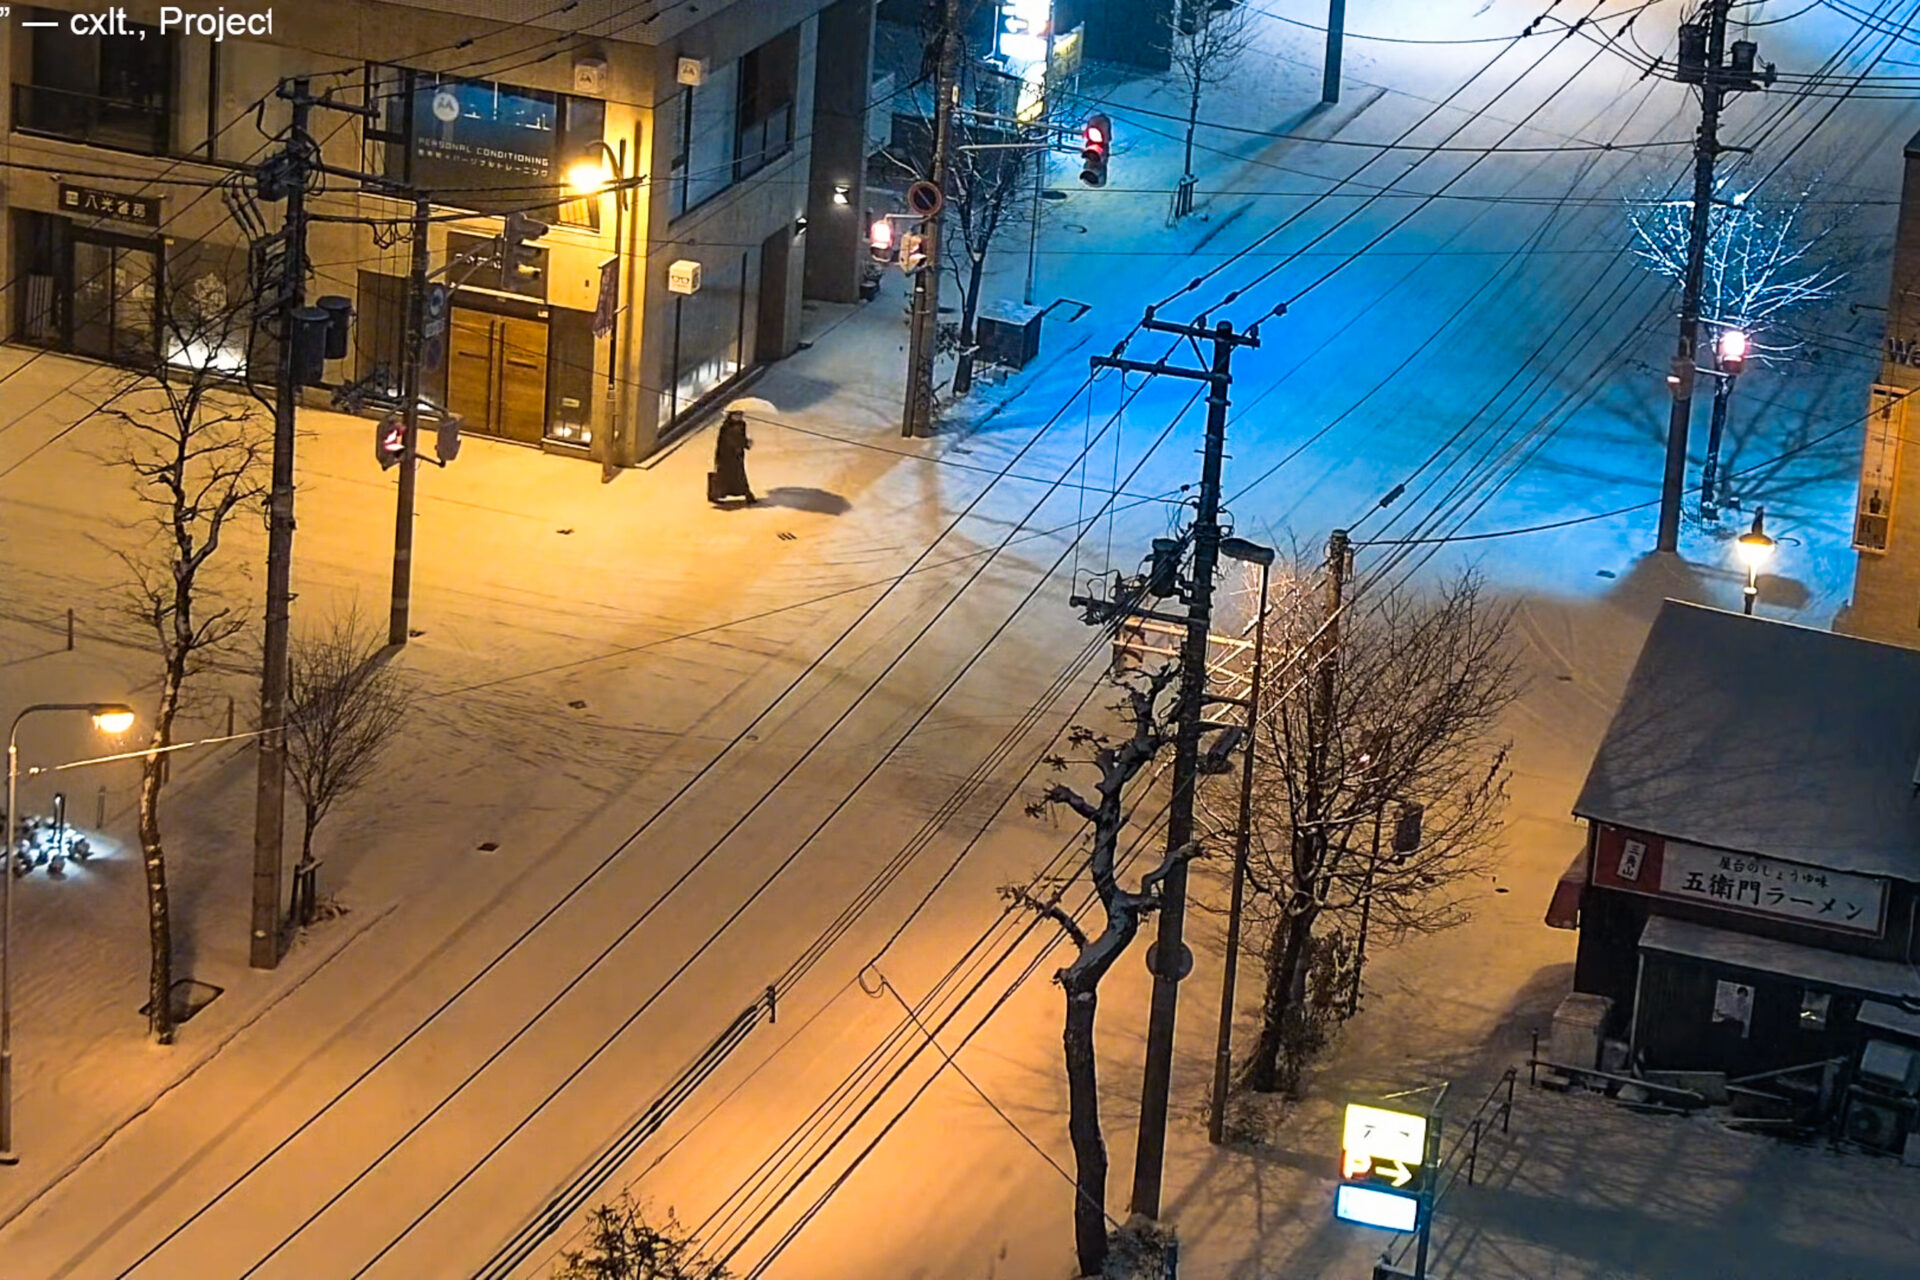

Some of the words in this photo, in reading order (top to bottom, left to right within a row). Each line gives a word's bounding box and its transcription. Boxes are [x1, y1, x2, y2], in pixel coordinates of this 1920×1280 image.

[418, 137, 471, 153] PERSONAL
[476, 147, 549, 166] CONDITIONING
[1718, 856, 1830, 888] 屋台のしょうゆ味
[1682, 872, 1864, 920] 五衛門ラーメン
